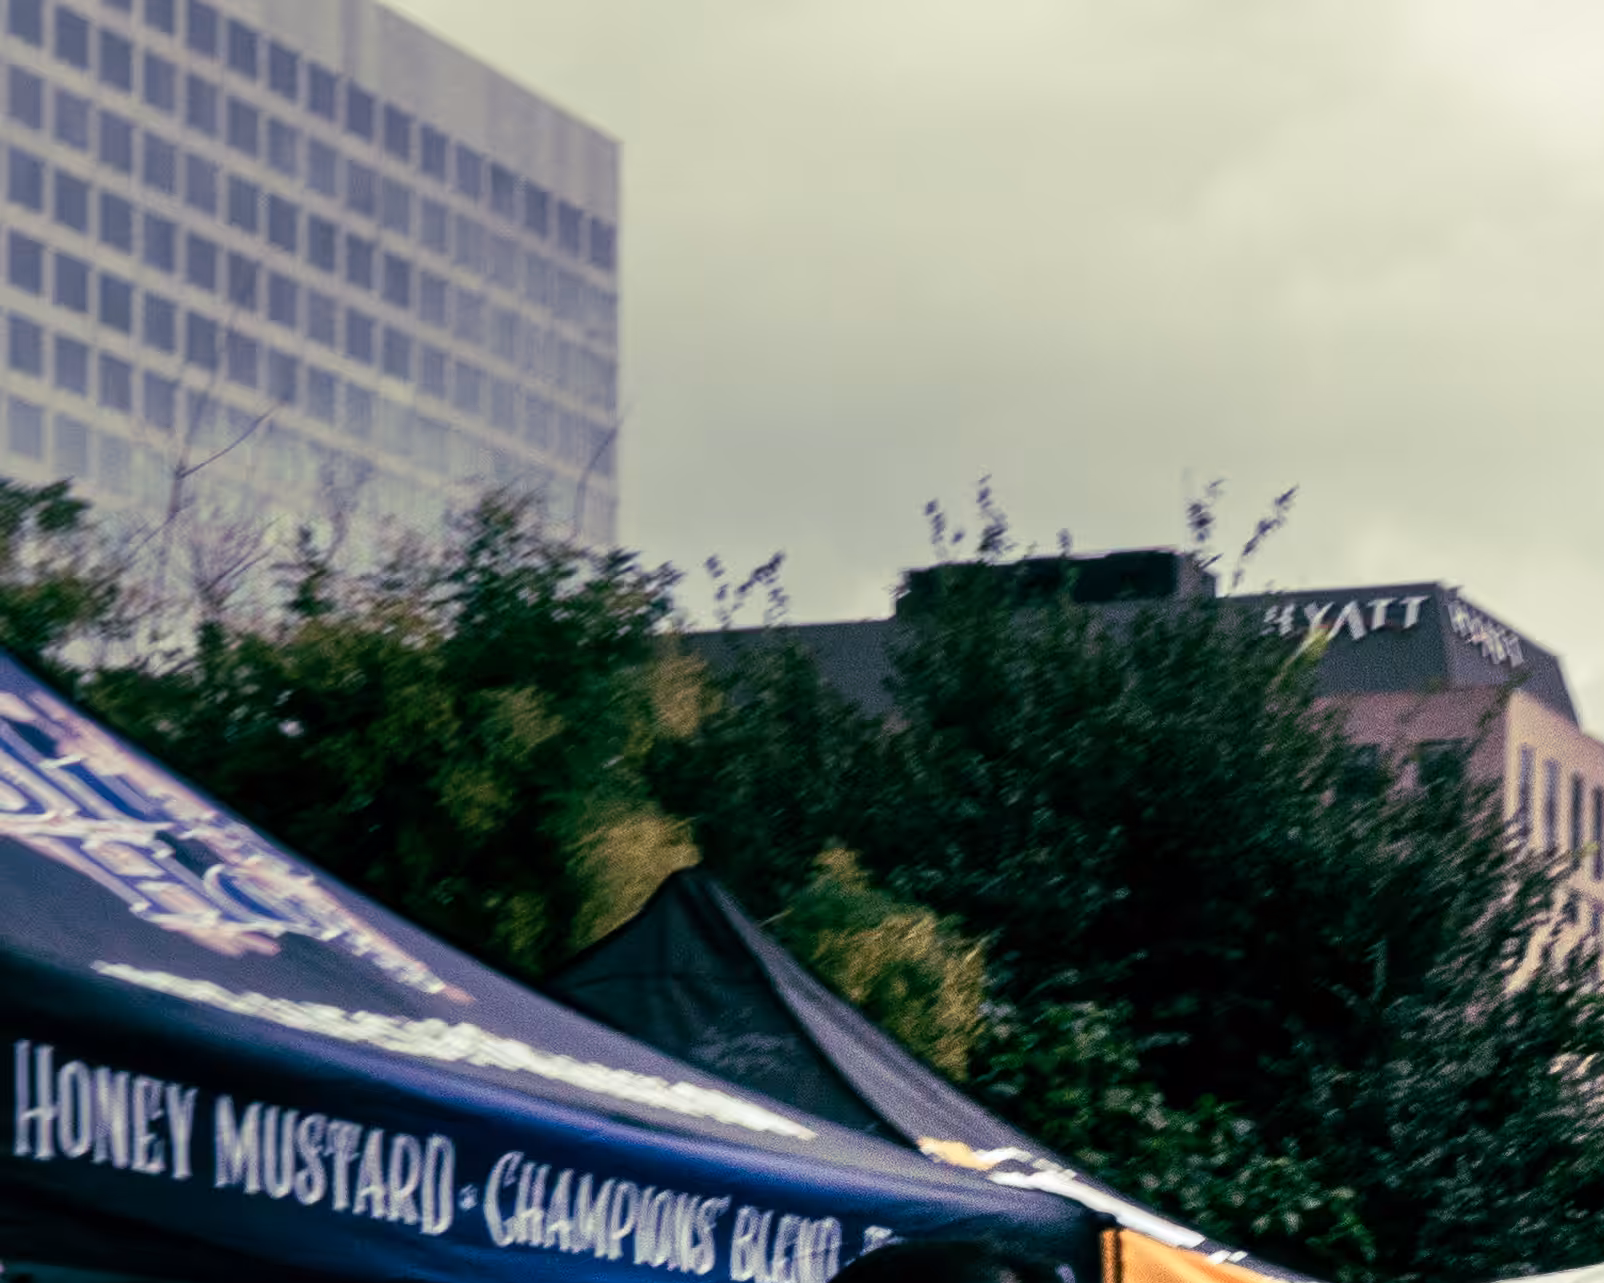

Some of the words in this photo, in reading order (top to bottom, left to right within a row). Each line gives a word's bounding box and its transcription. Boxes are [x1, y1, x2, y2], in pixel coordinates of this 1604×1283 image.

[1258, 595, 1431, 642] HYATT
[13, 1038, 199, 1180] HONEY
[214, 1094, 456, 1237] MUSTARD
